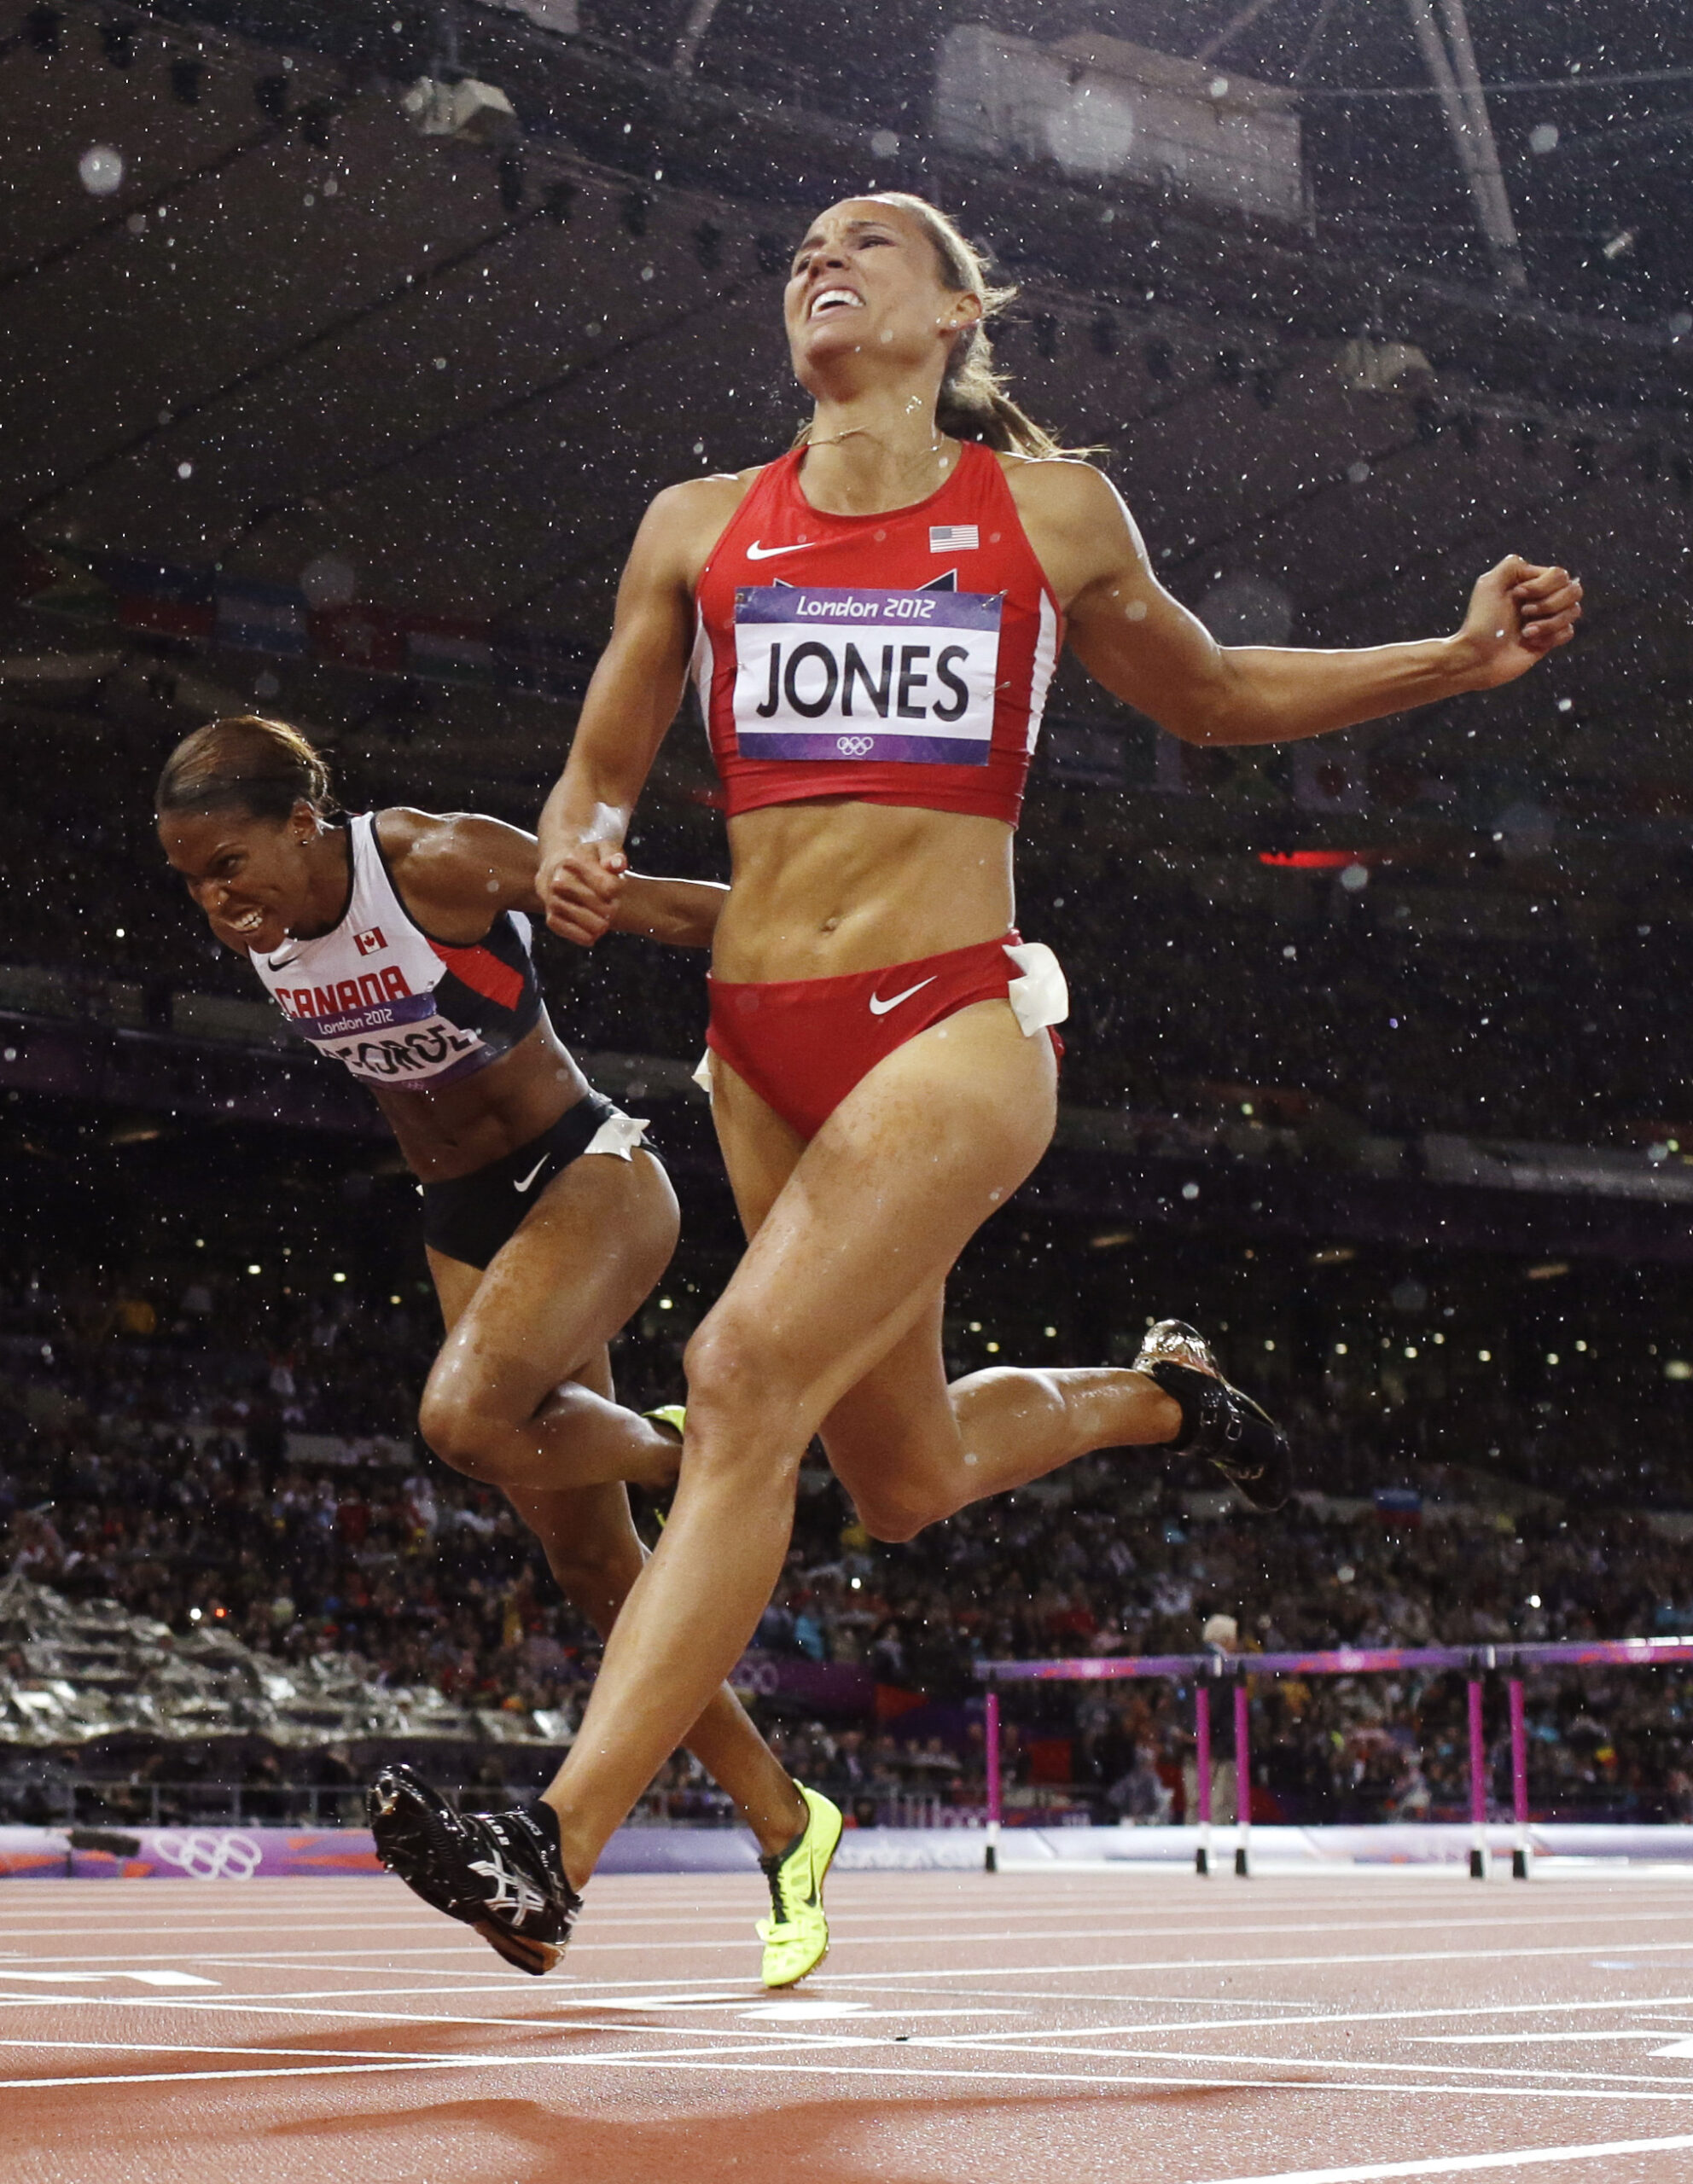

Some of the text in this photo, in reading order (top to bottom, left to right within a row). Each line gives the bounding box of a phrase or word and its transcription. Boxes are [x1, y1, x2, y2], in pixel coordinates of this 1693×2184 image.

[795, 595, 936, 619] London 2012
[756, 640, 969, 723] JONES
[275, 965, 413, 1019] CANADA
[317, 1008, 395, 1035] London 2012
